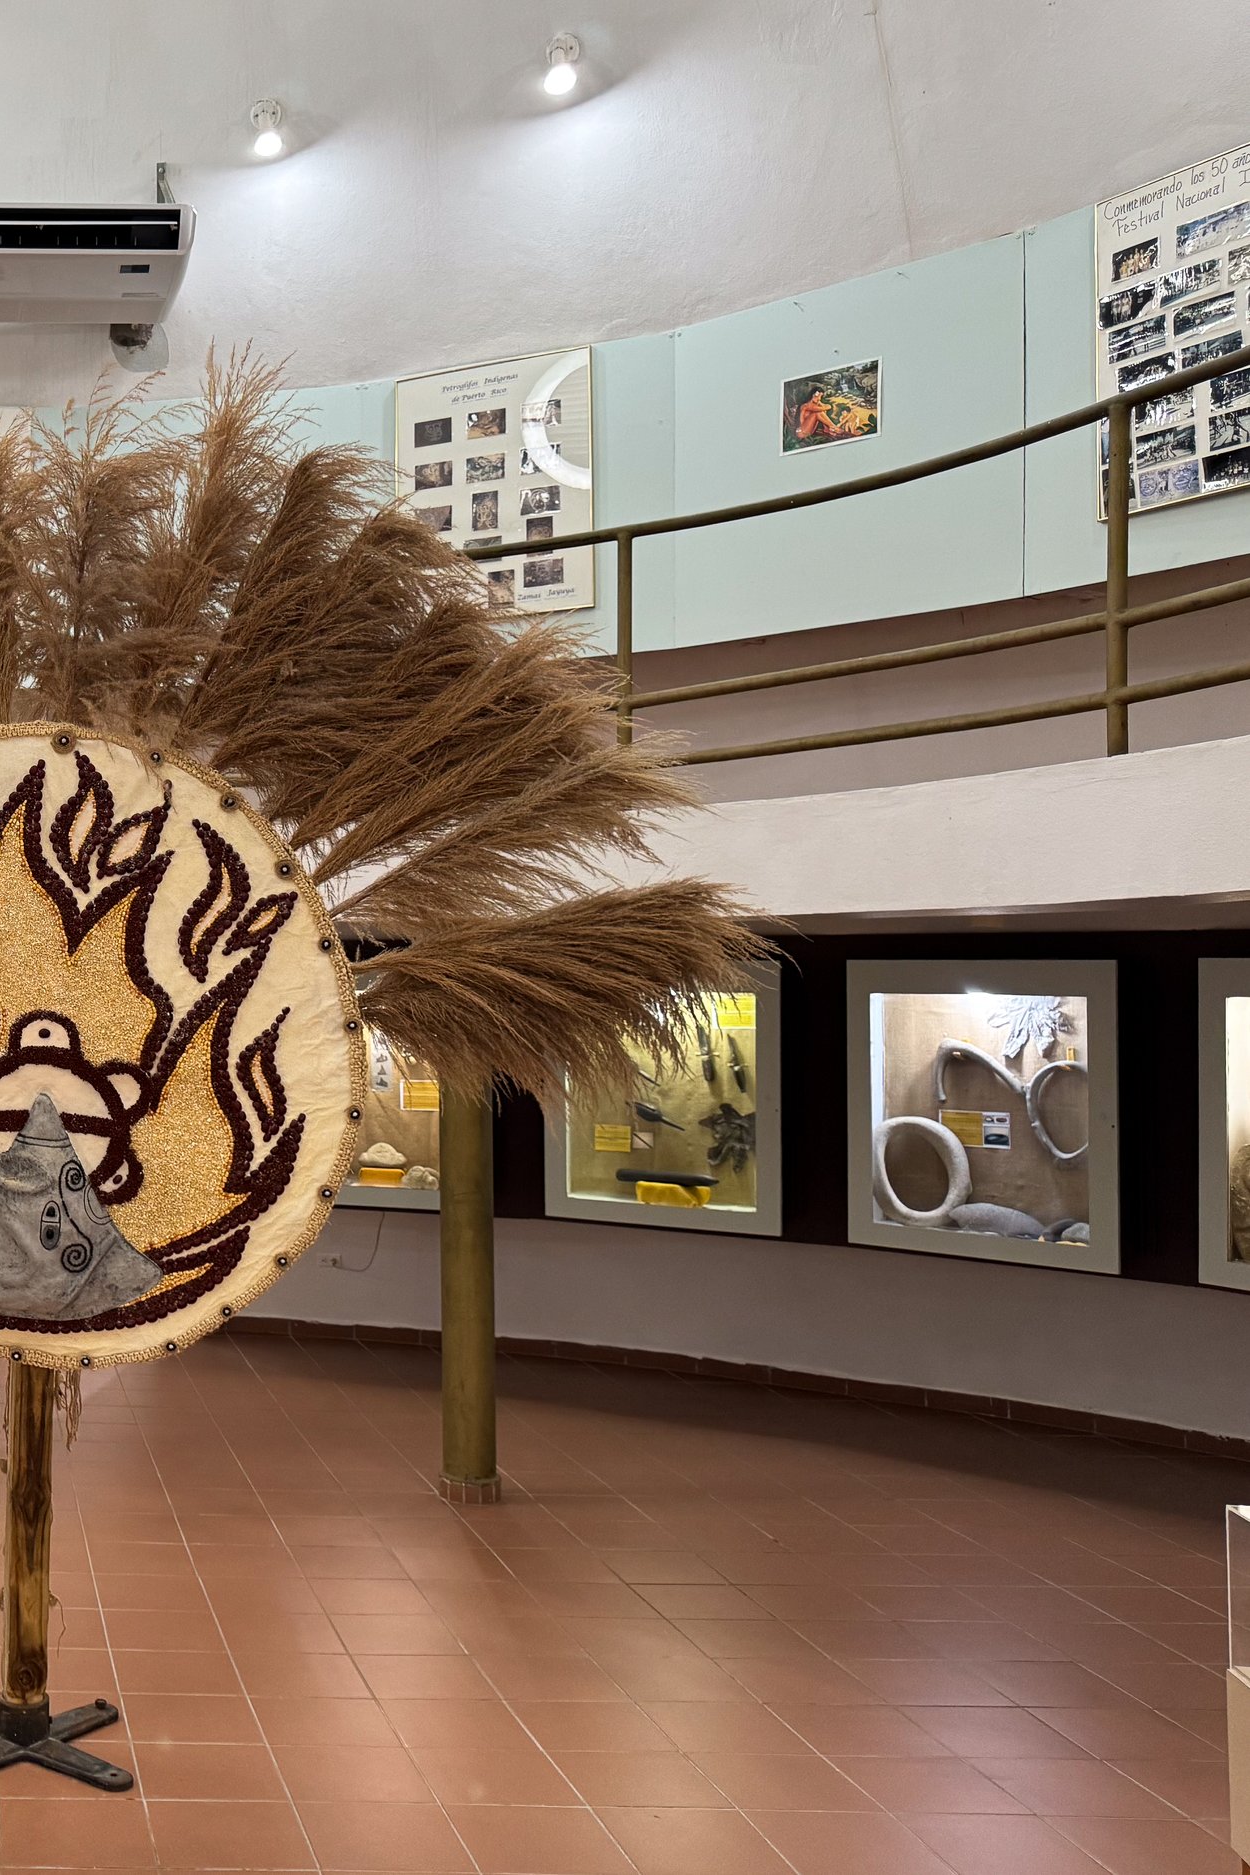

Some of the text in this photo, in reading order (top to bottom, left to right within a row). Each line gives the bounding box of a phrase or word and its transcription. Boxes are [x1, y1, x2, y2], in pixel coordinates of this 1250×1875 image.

[1104, 175, 1183, 220] Conmemorando
[1191, 168, 1205, 185] los
[1211, 157, 1229, 178] 50
[1112, 201, 1165, 237] Festival
[1176, 176, 1226, 211] Nacional
[461, 392, 486, 401] Puerto
[491, 387, 507, 396] Rico
